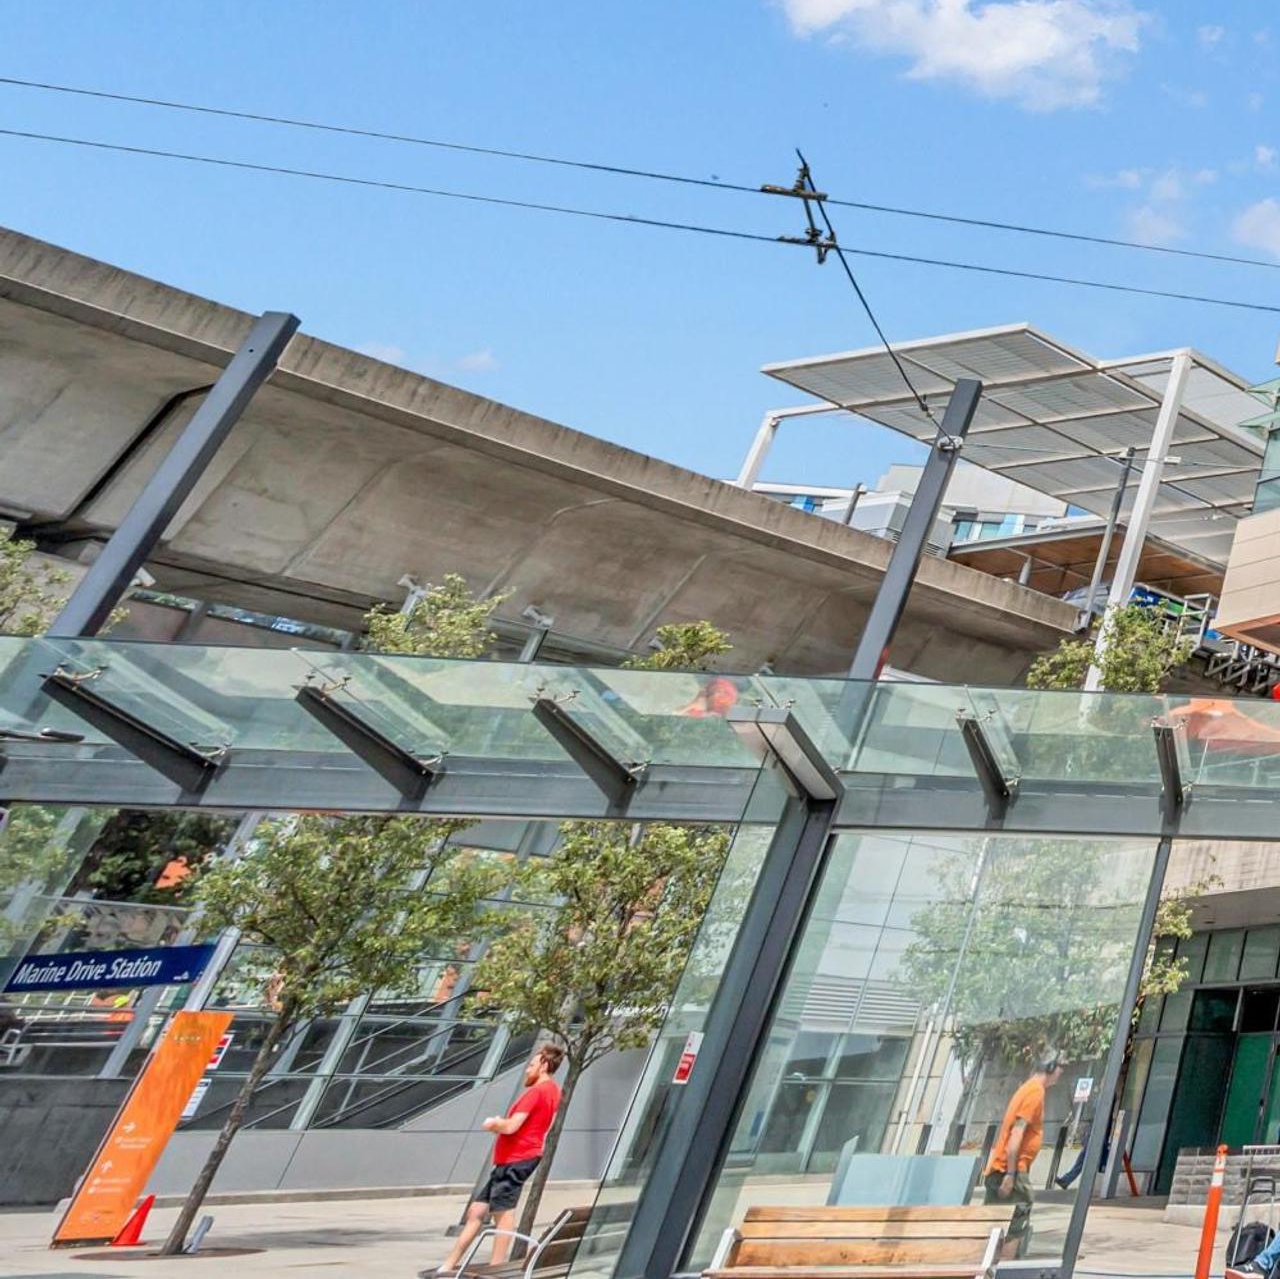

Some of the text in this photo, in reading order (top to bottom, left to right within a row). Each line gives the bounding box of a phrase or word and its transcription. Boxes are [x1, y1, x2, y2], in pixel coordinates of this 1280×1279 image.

[13, 955, 162, 985] Marine Drive Station
